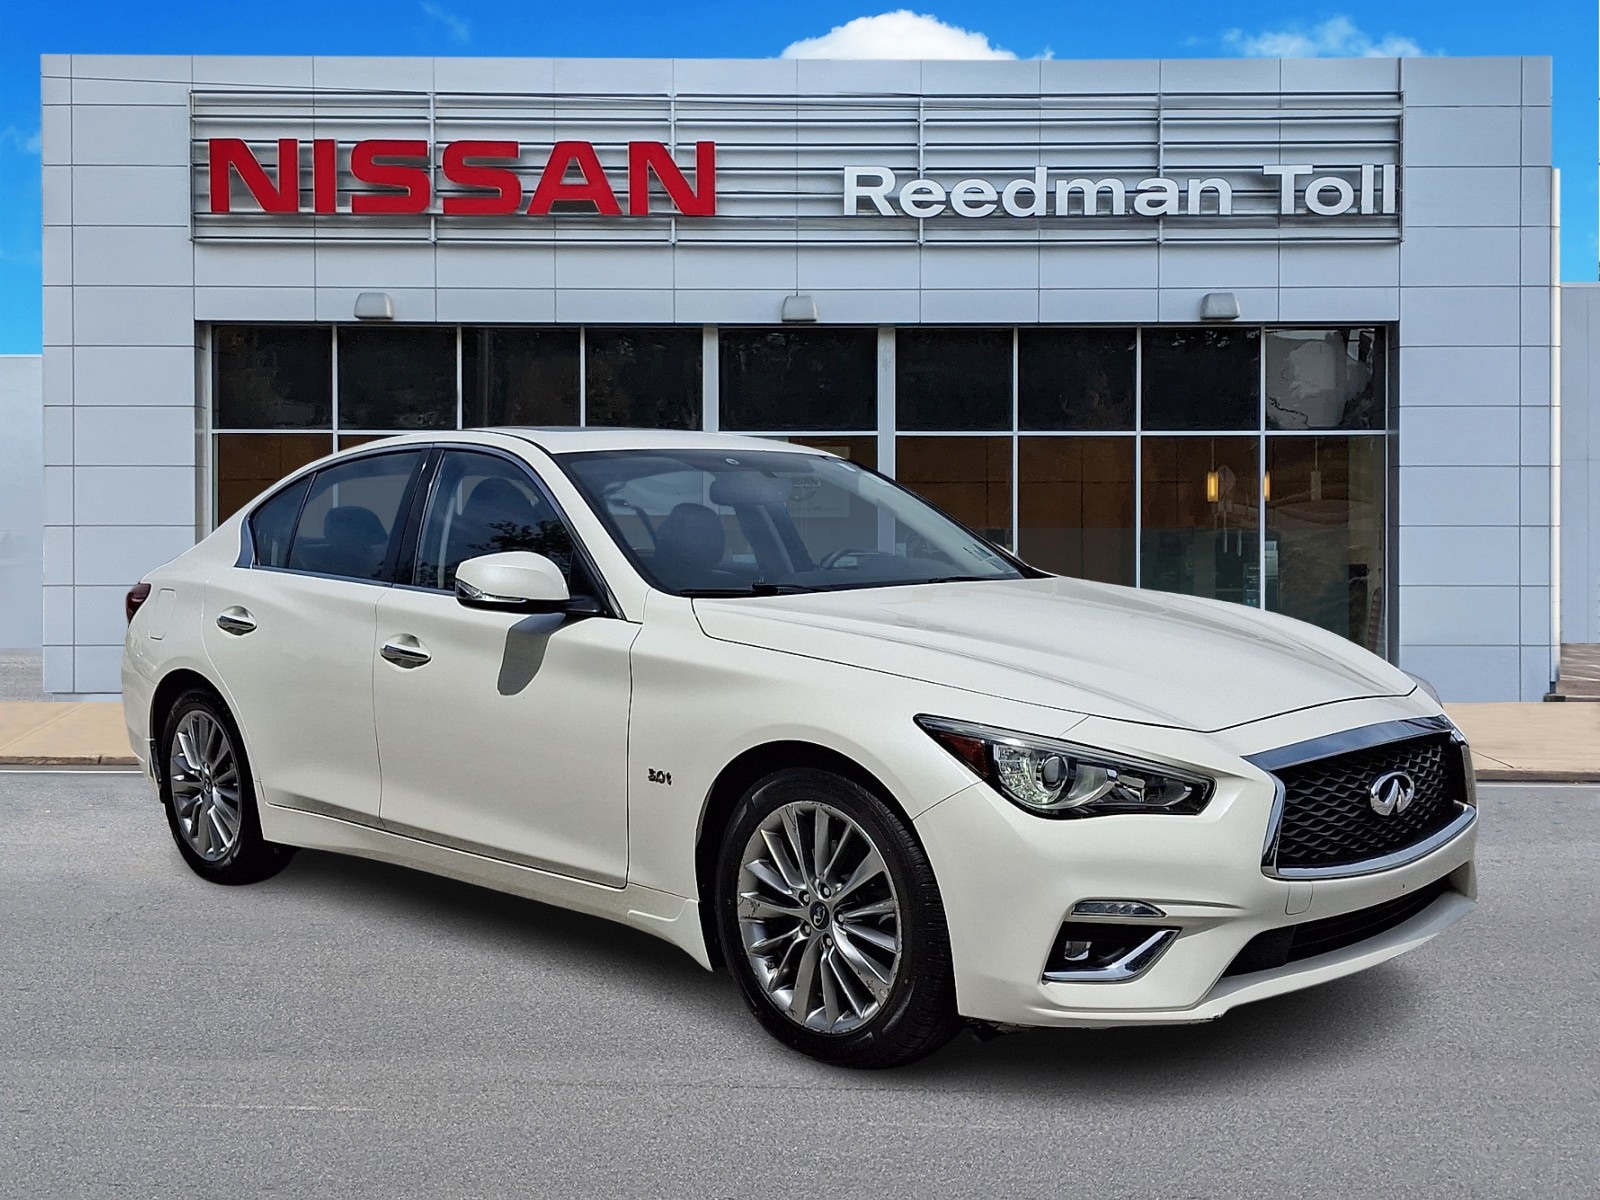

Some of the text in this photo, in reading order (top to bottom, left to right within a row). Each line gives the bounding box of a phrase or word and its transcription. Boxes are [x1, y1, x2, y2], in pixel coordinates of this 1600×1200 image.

[208, 138, 716, 216] NISSAN
[842, 163, 1396, 218] Reedman Toll
